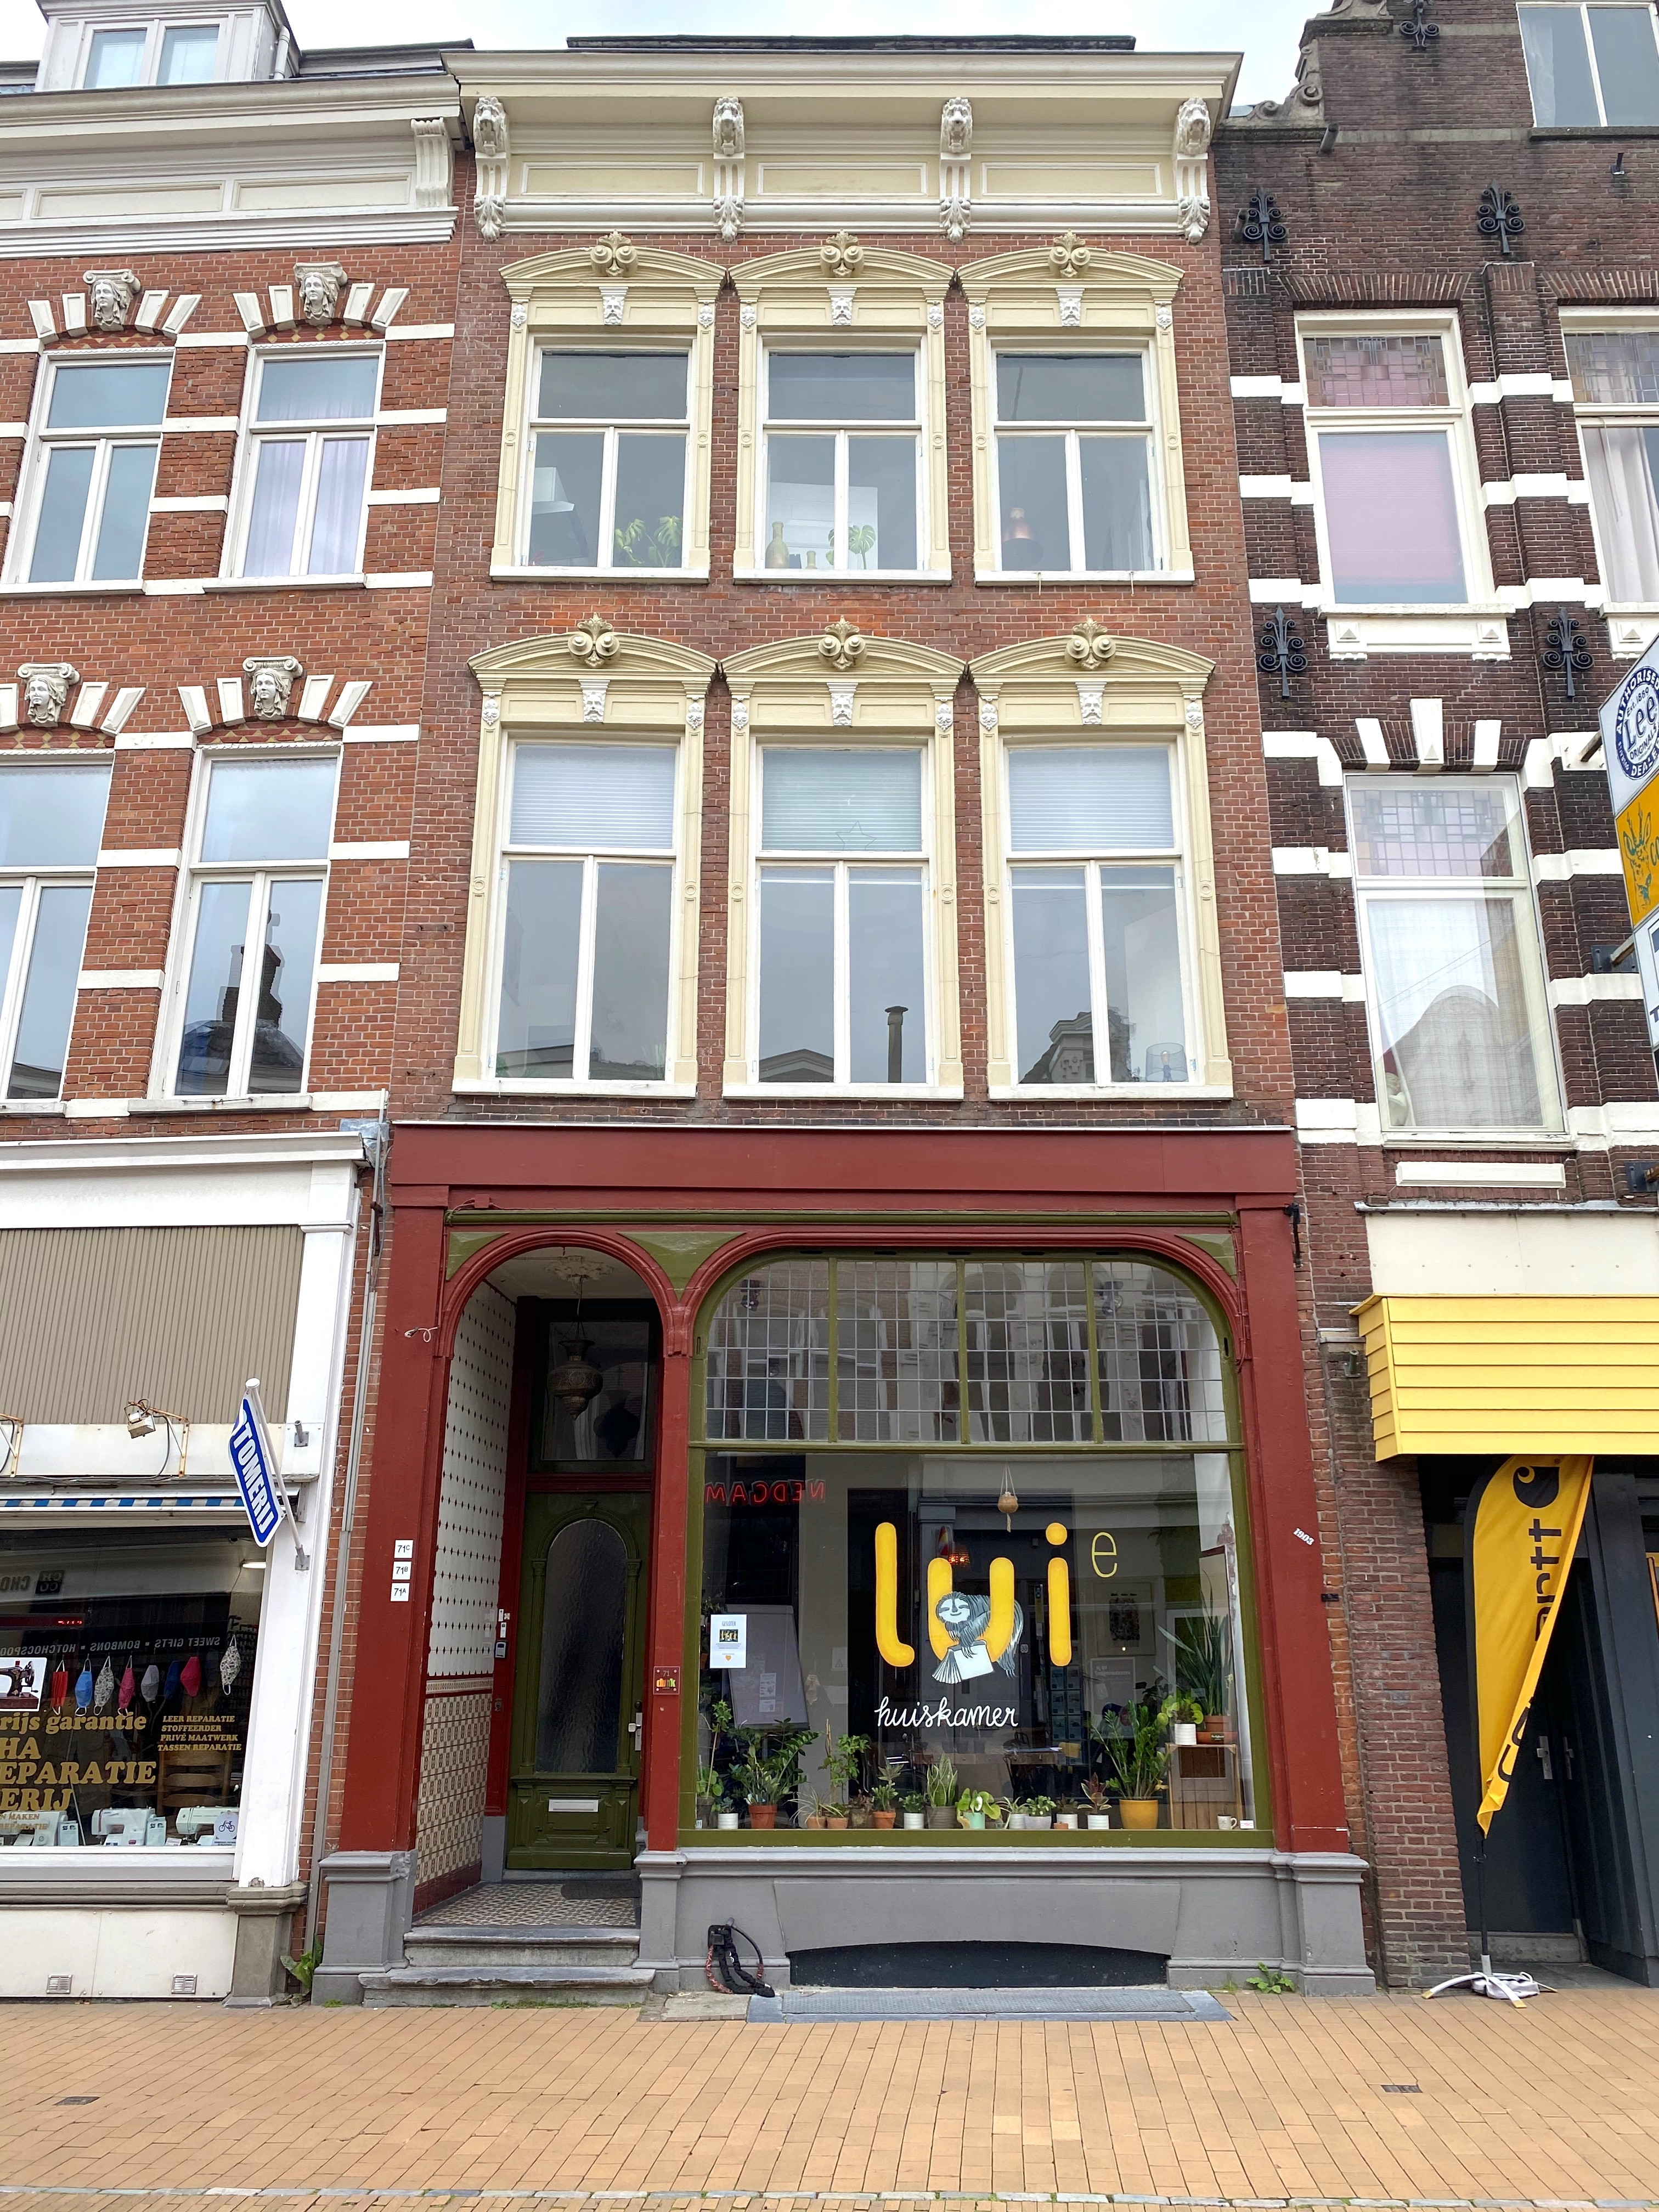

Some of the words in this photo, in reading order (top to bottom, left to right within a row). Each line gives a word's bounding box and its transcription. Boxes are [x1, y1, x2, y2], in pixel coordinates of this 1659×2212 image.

[1616, 669, 1659, 735] AUTHORISED
[1624, 696, 1657, 752] Lee
[1630, 723, 1657, 760] ORIGINALS
[398, 1544, 410, 1553] 71C
[396, 1566, 408, 1575] 71B
[394, 1588, 407, 1596] 71A
[875, 1522, 1071, 1667] lui
[1091, 1532, 1118, 1578] e
[0, 1712, 40, 1735] rijs
[46, 1712, 147, 1735] garantie
[874, 1696, 1018, 1728] huiskamer
[0, 1737, 41, 1759] HA
[160, 1733, 187, 1741] PRIVÉ
[0, 1761, 157, 1785] EPARATIE
[0, 1788, 75, 1811] ERIJ
